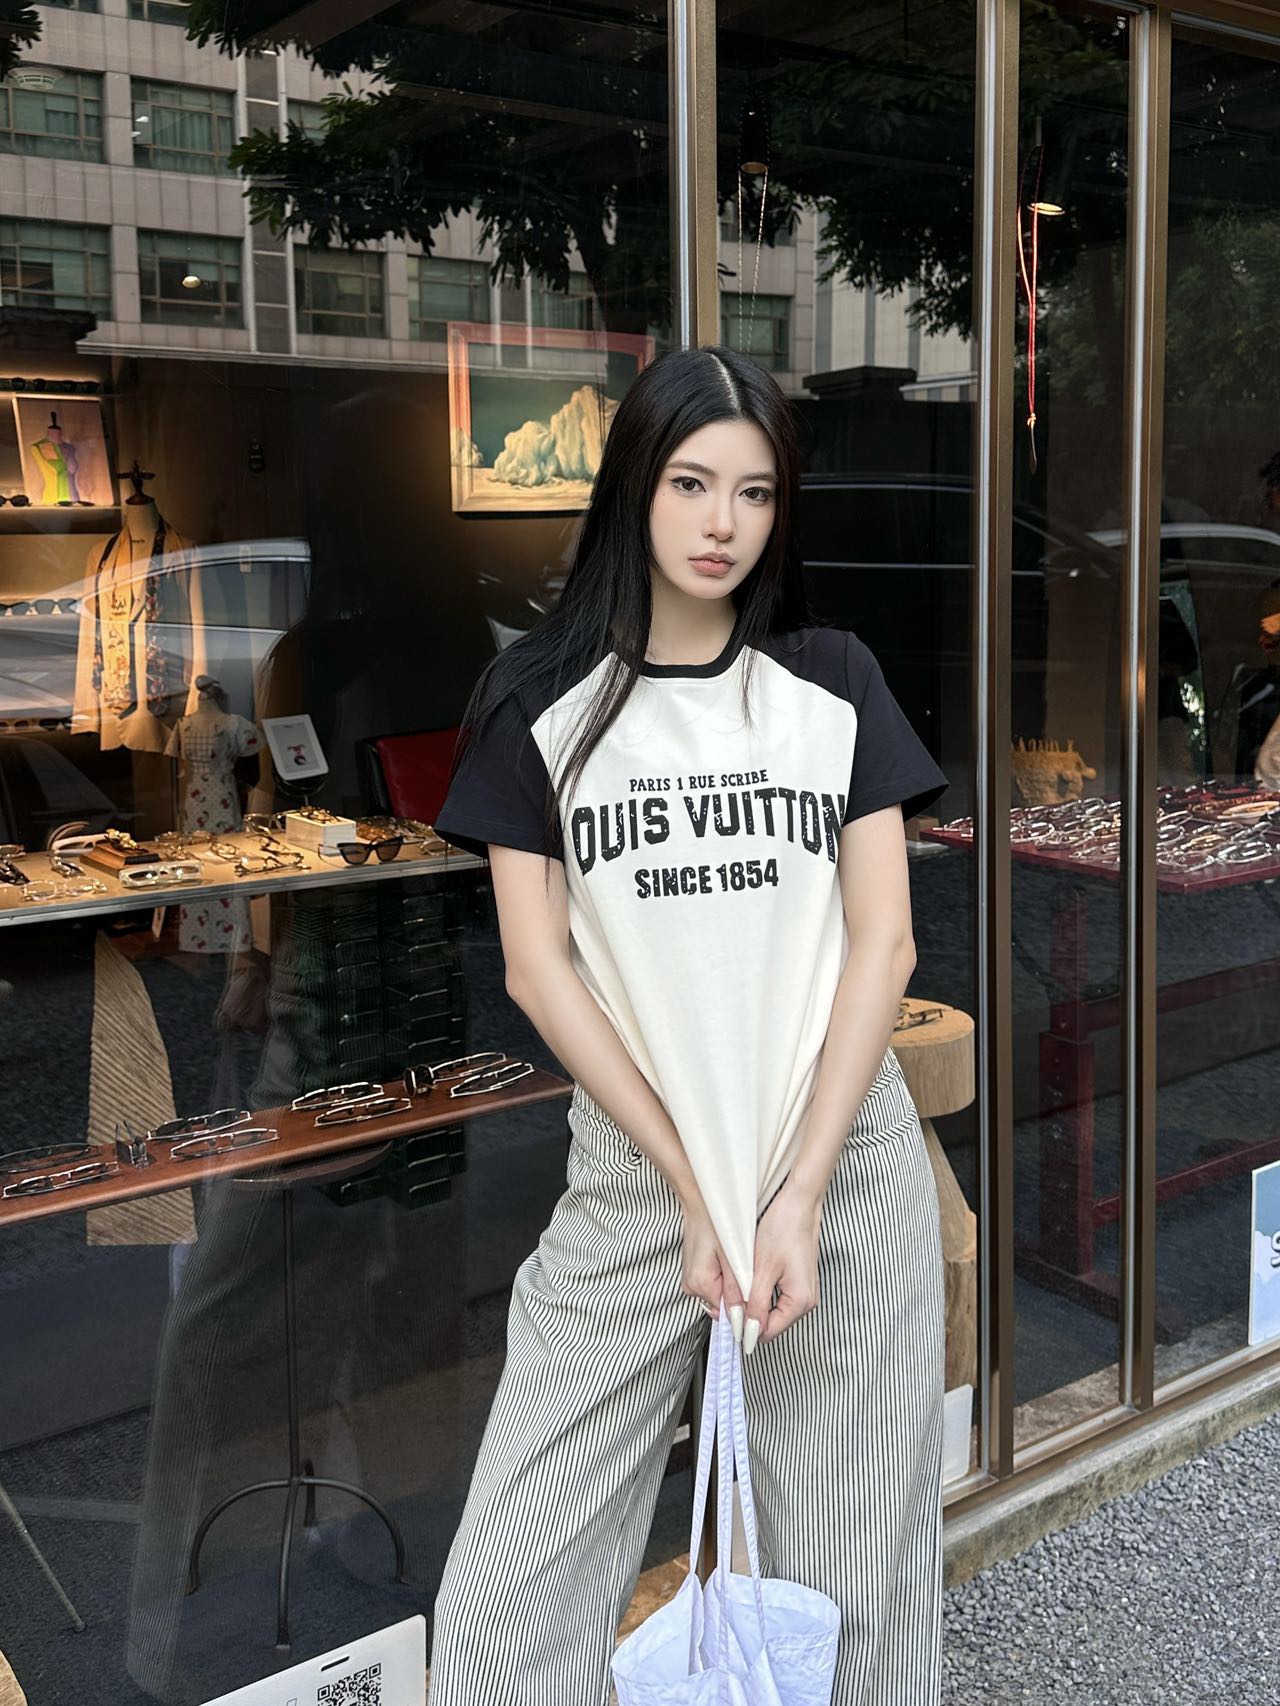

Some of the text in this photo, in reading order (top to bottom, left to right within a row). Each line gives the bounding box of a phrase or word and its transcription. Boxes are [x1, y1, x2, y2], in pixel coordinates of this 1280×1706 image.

[629, 769, 768, 792] PARIS 1 RUE SCRIBE
[683, 787, 845, 864] VUITTON
[634, 858, 779, 899] SINCE 1854
